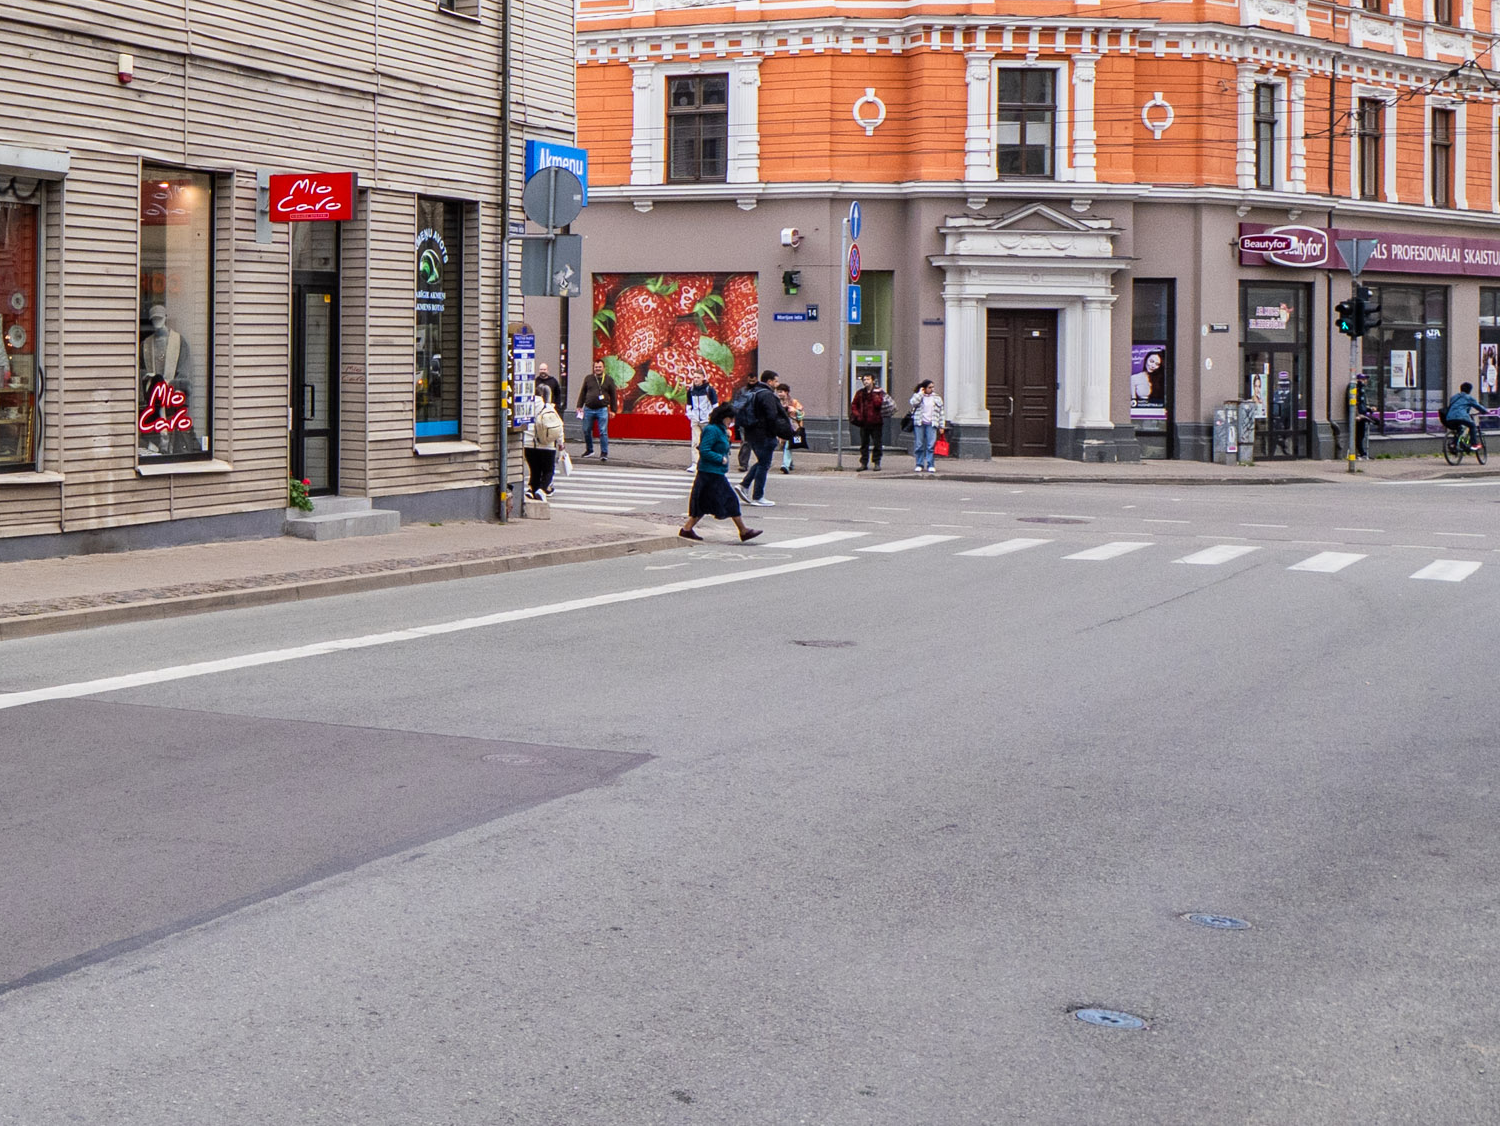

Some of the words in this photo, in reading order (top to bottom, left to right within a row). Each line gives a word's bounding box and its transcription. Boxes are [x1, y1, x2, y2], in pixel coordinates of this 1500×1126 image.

[289, 178, 333, 195] Mio
[277, 195, 342, 212] Caro
[1243, 238, 1288, 251] Beautyfor
[1391, 243, 1461, 263] PROFESIONĀLAI
[1463, 249, 1500, 266] SKAISTU
[149, 382, 185, 406] Mio
[140, 407, 191, 431] Caro
